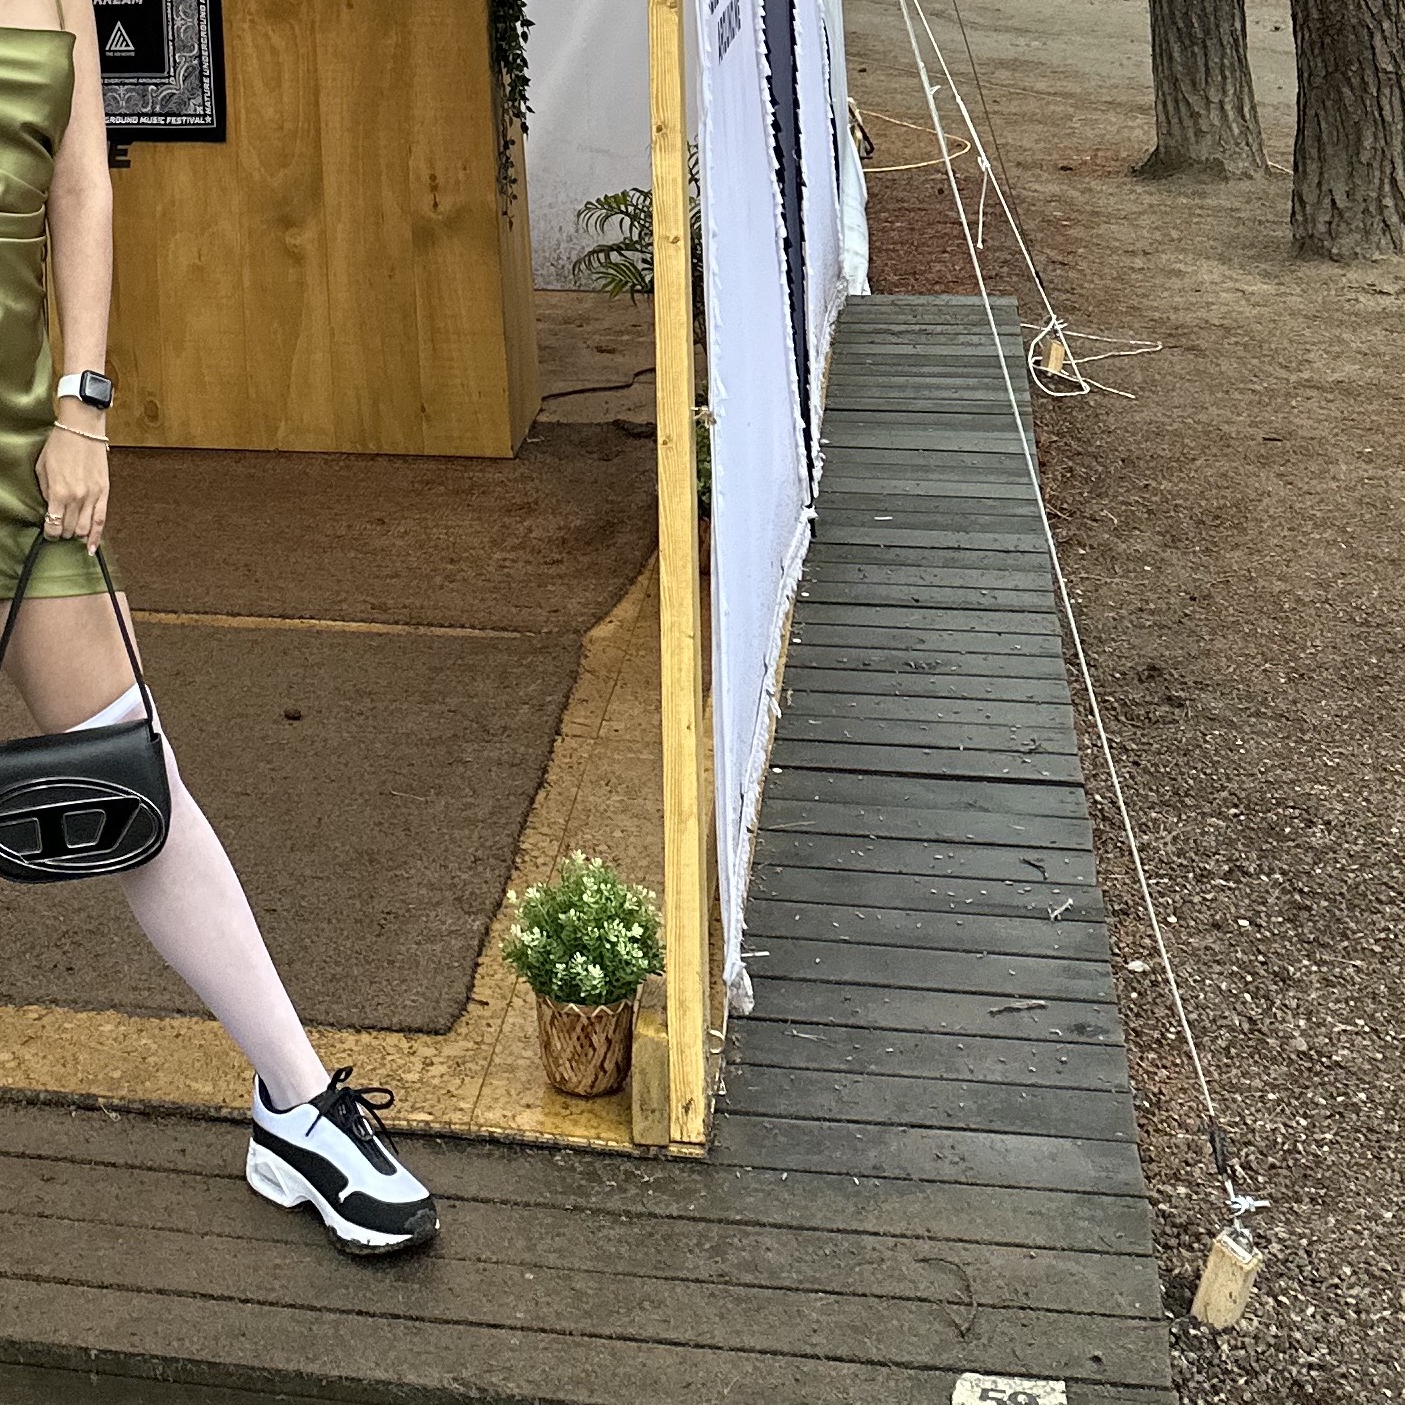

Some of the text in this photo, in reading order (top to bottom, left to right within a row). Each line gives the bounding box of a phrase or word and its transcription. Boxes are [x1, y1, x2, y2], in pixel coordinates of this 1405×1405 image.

[199, 5, 209, 75] UNDERGROUND
[202, 77, 211, 114] NATURE
[105, 116, 205, 124] GROUND MUSIC FESTIVAL
